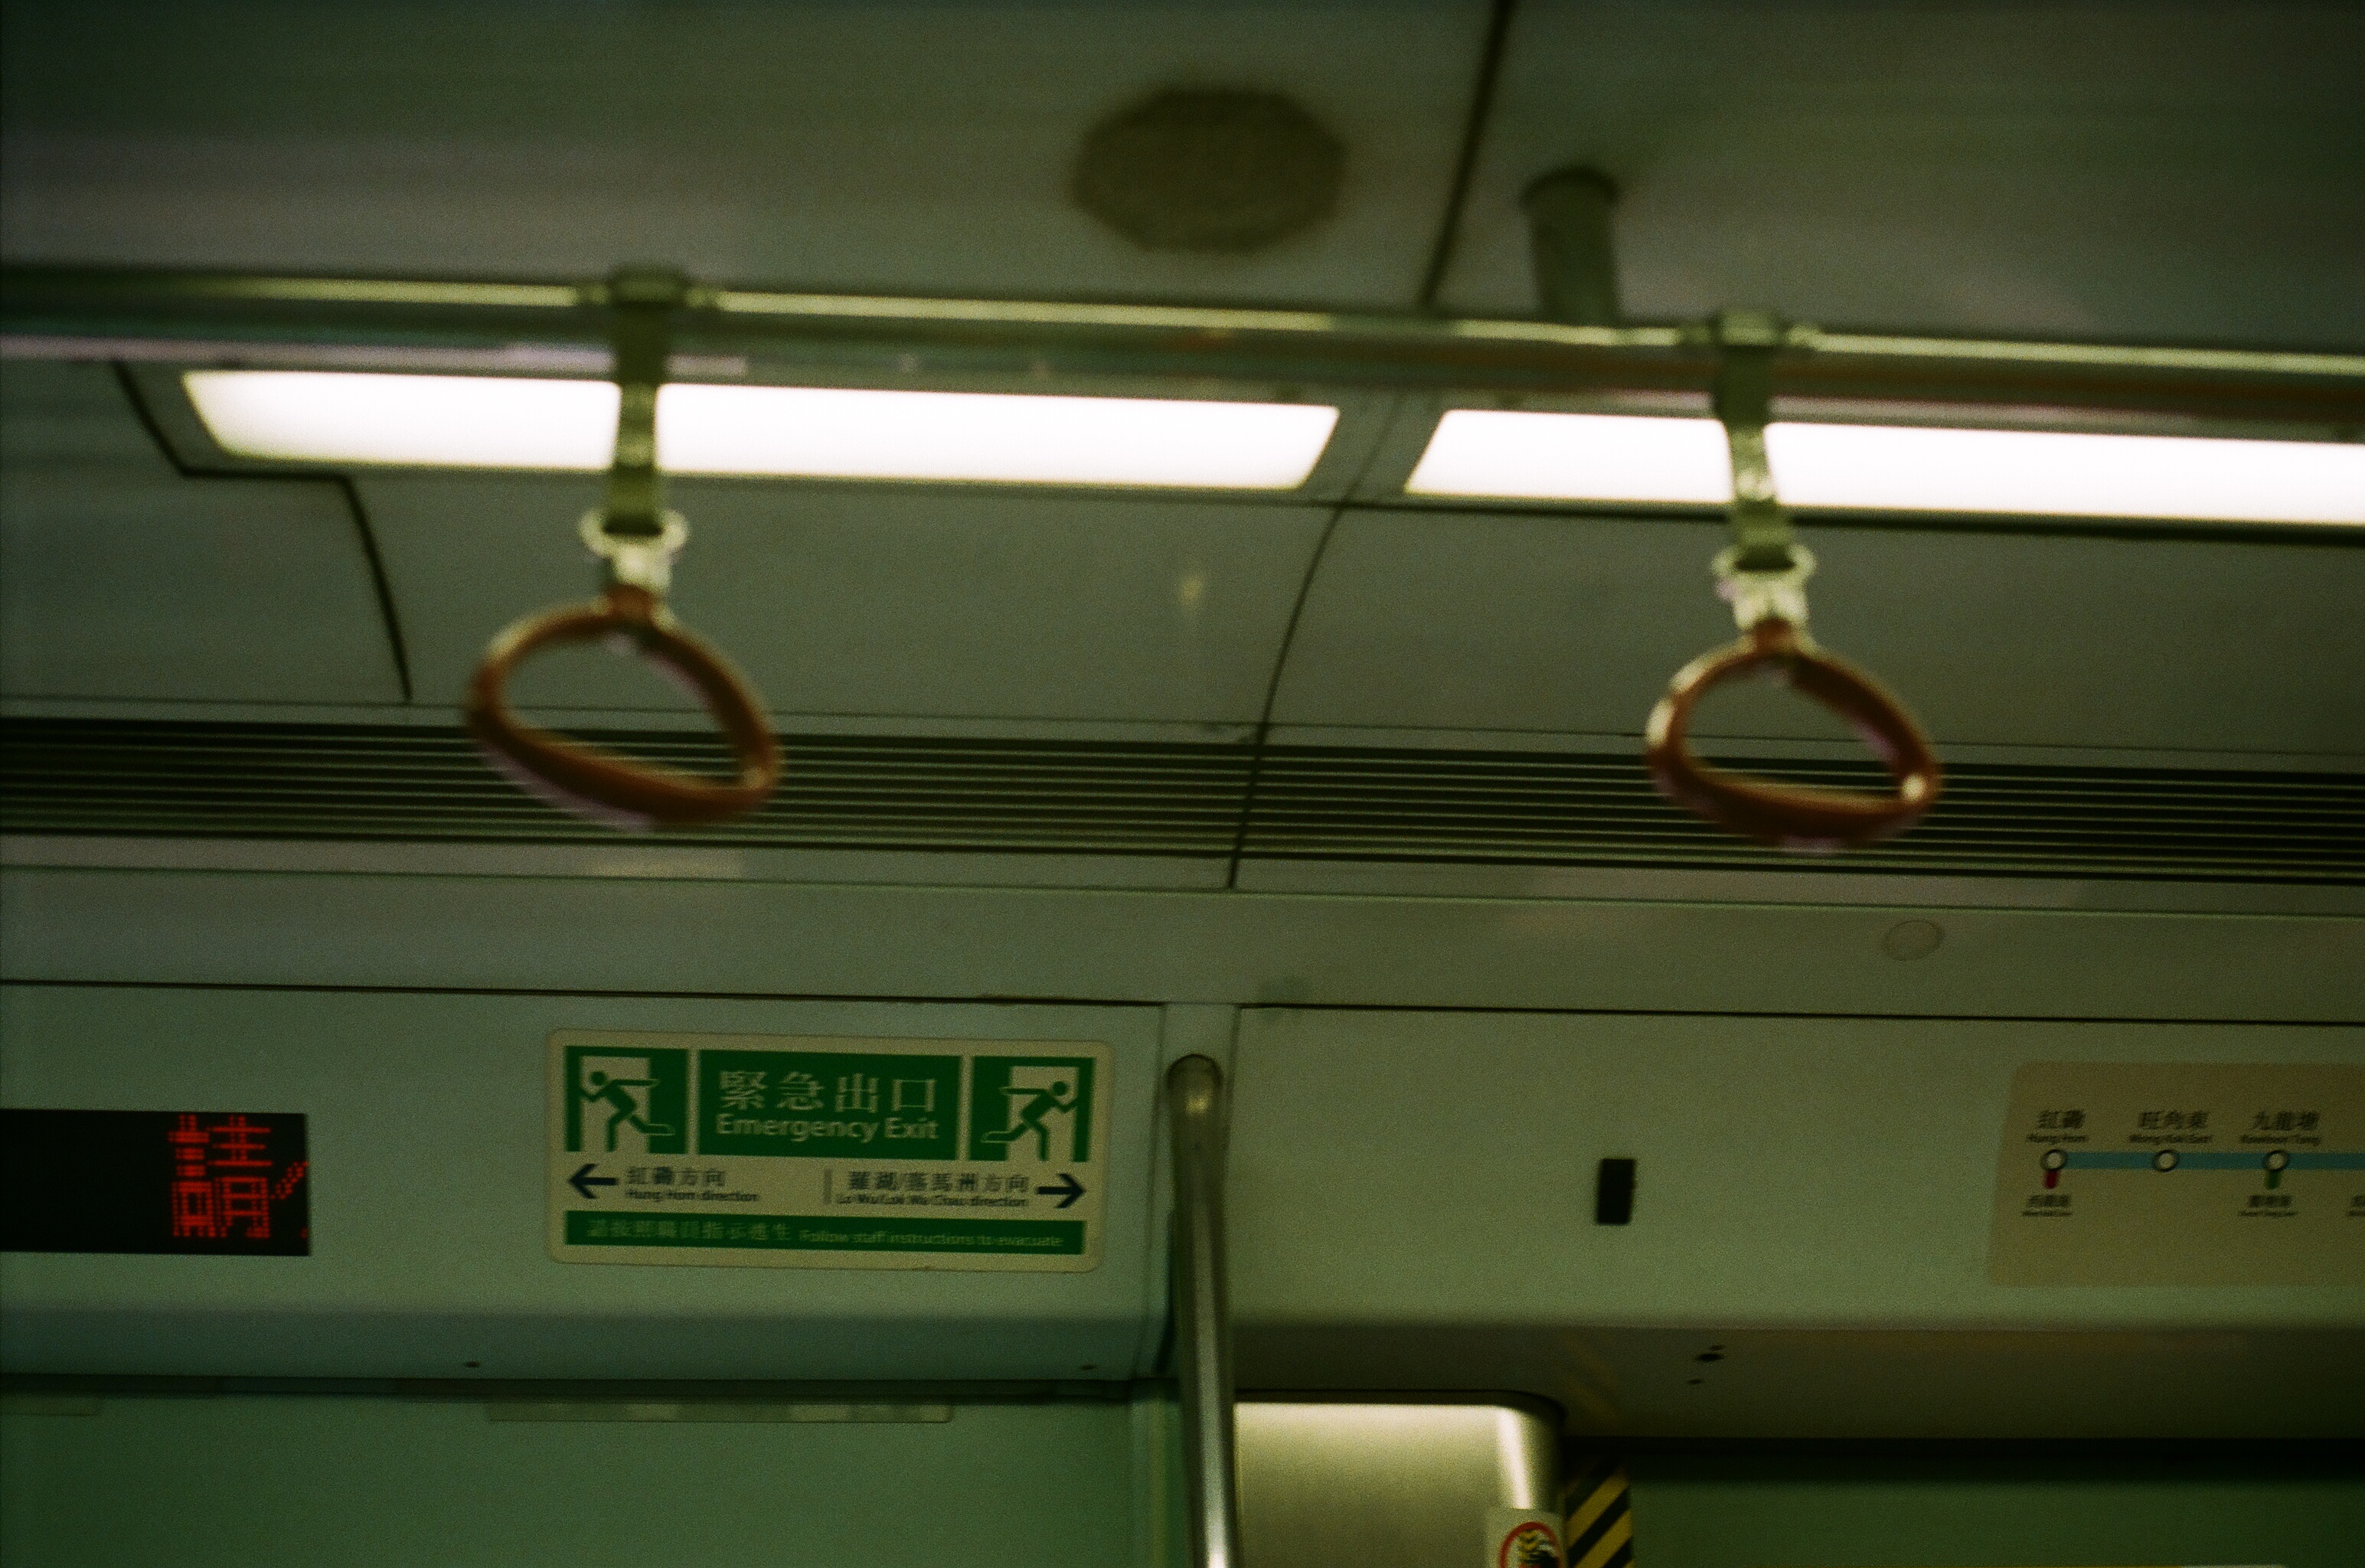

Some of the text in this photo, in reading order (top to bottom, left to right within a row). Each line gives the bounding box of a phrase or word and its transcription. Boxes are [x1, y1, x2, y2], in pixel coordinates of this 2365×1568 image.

[717, 1070, 937, 1113] 緊急出口
[716, 1112, 939, 1143] Emergency Exit
[167, 1115, 310, 1239] 請
